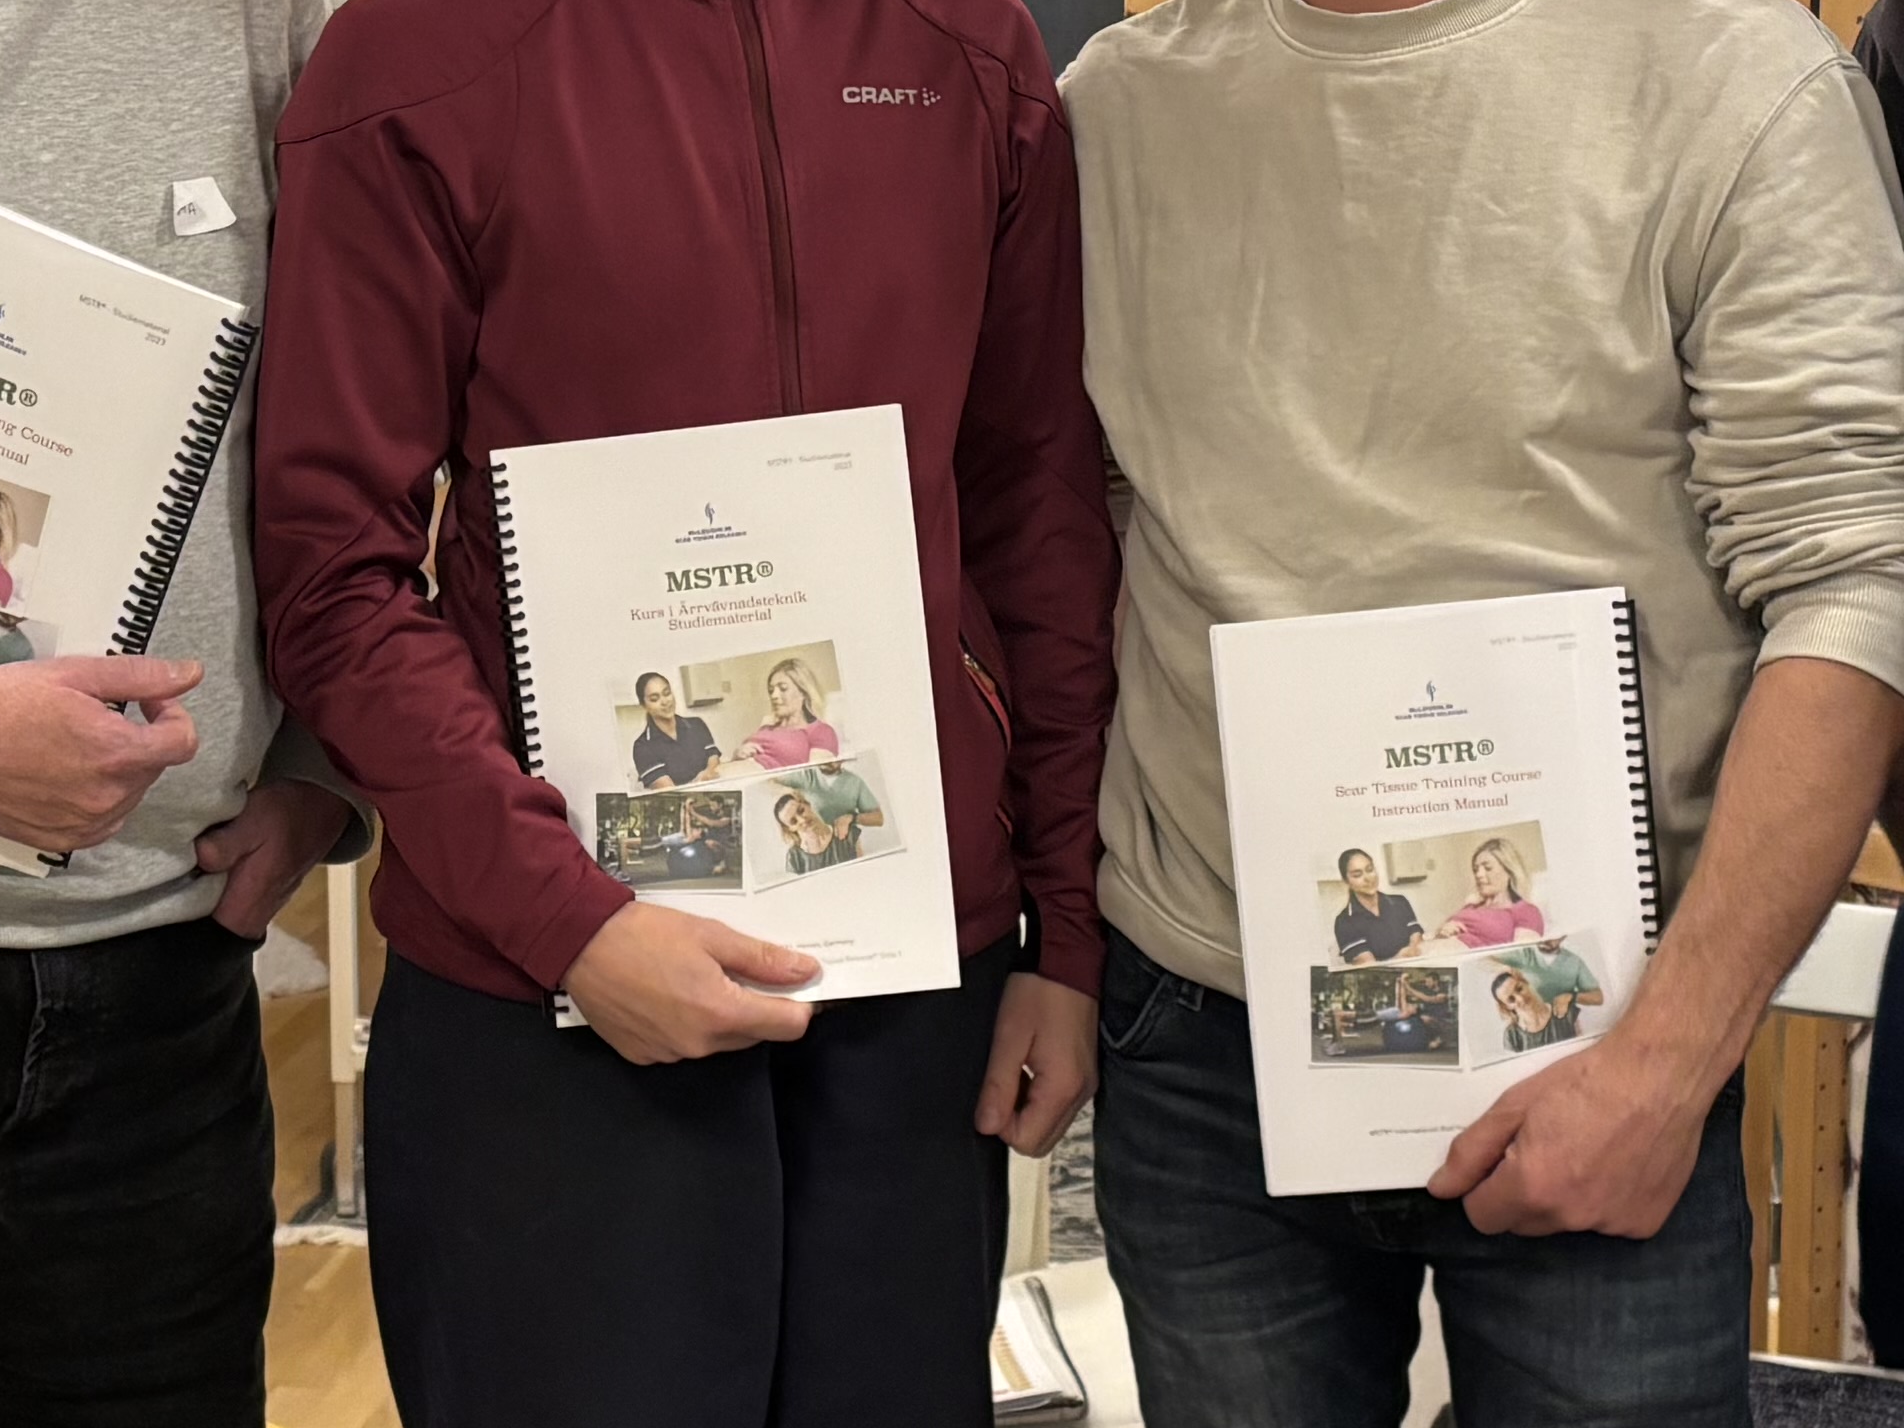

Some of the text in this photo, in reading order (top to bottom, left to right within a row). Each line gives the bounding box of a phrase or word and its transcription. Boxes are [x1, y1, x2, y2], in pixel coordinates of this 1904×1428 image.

[842, 85, 918, 105] CRAFT
[20, 426, 74, 458] Course
[629, 608, 665, 622] Kurs
[667, 607, 772, 632] Studiematerial
[1334, 770, 1542, 798] Scar Tissue Training Course
[1371, 793, 1509, 818] Instruction Manual
